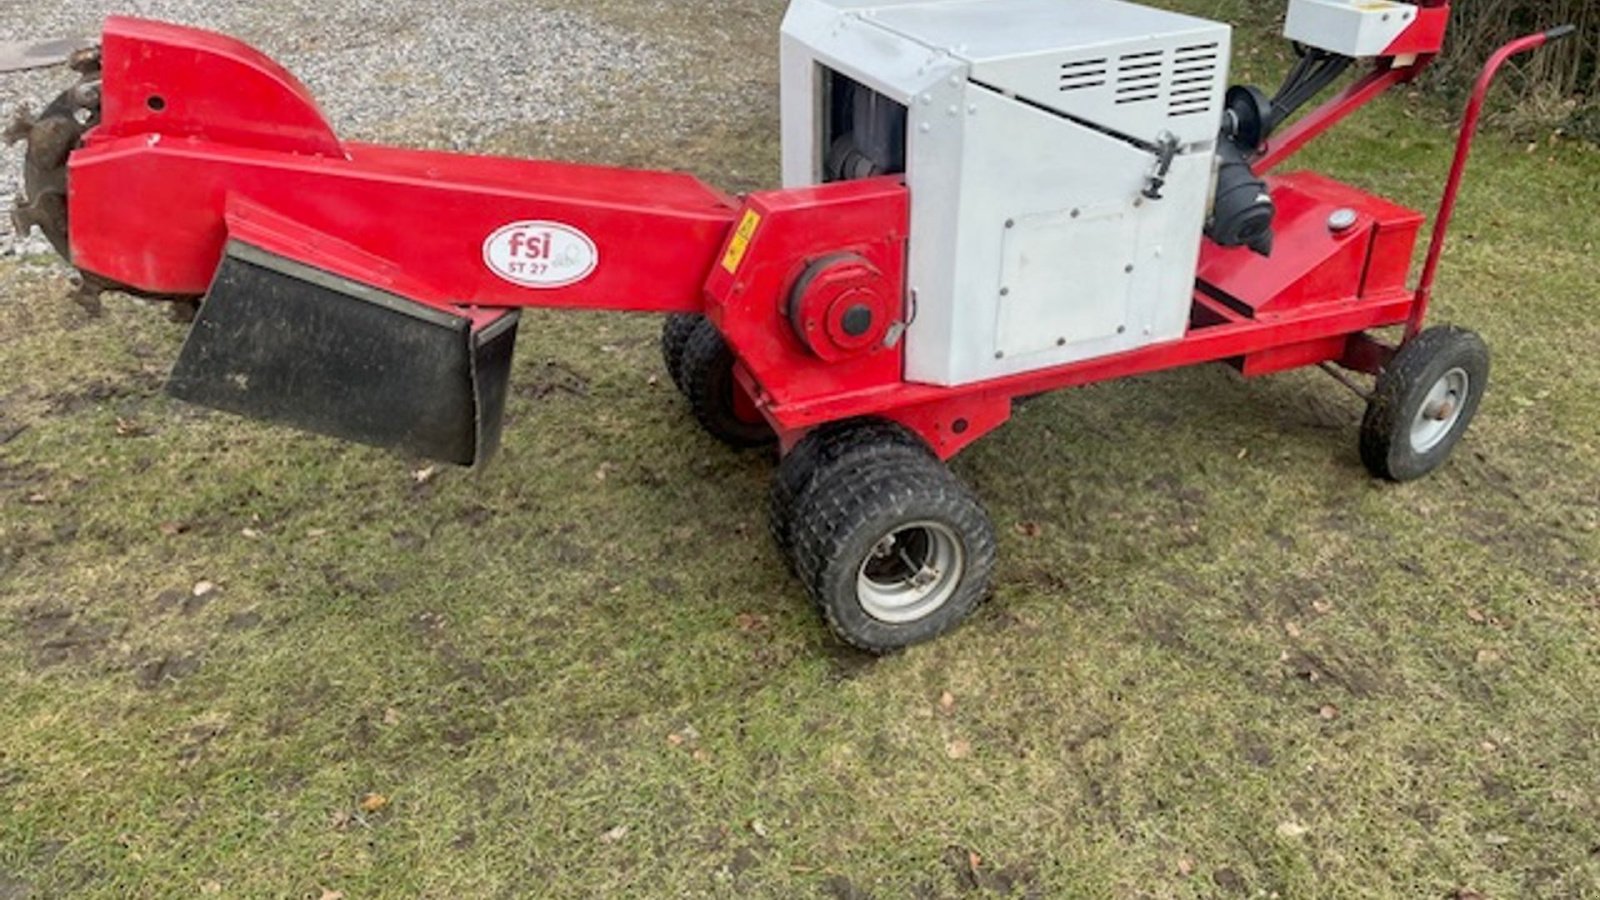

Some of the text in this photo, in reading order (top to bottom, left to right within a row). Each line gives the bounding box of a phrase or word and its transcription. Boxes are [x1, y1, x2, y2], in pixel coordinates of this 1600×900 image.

[508, 232, 551, 259] fsi
[509, 262, 548, 275] ST 27
